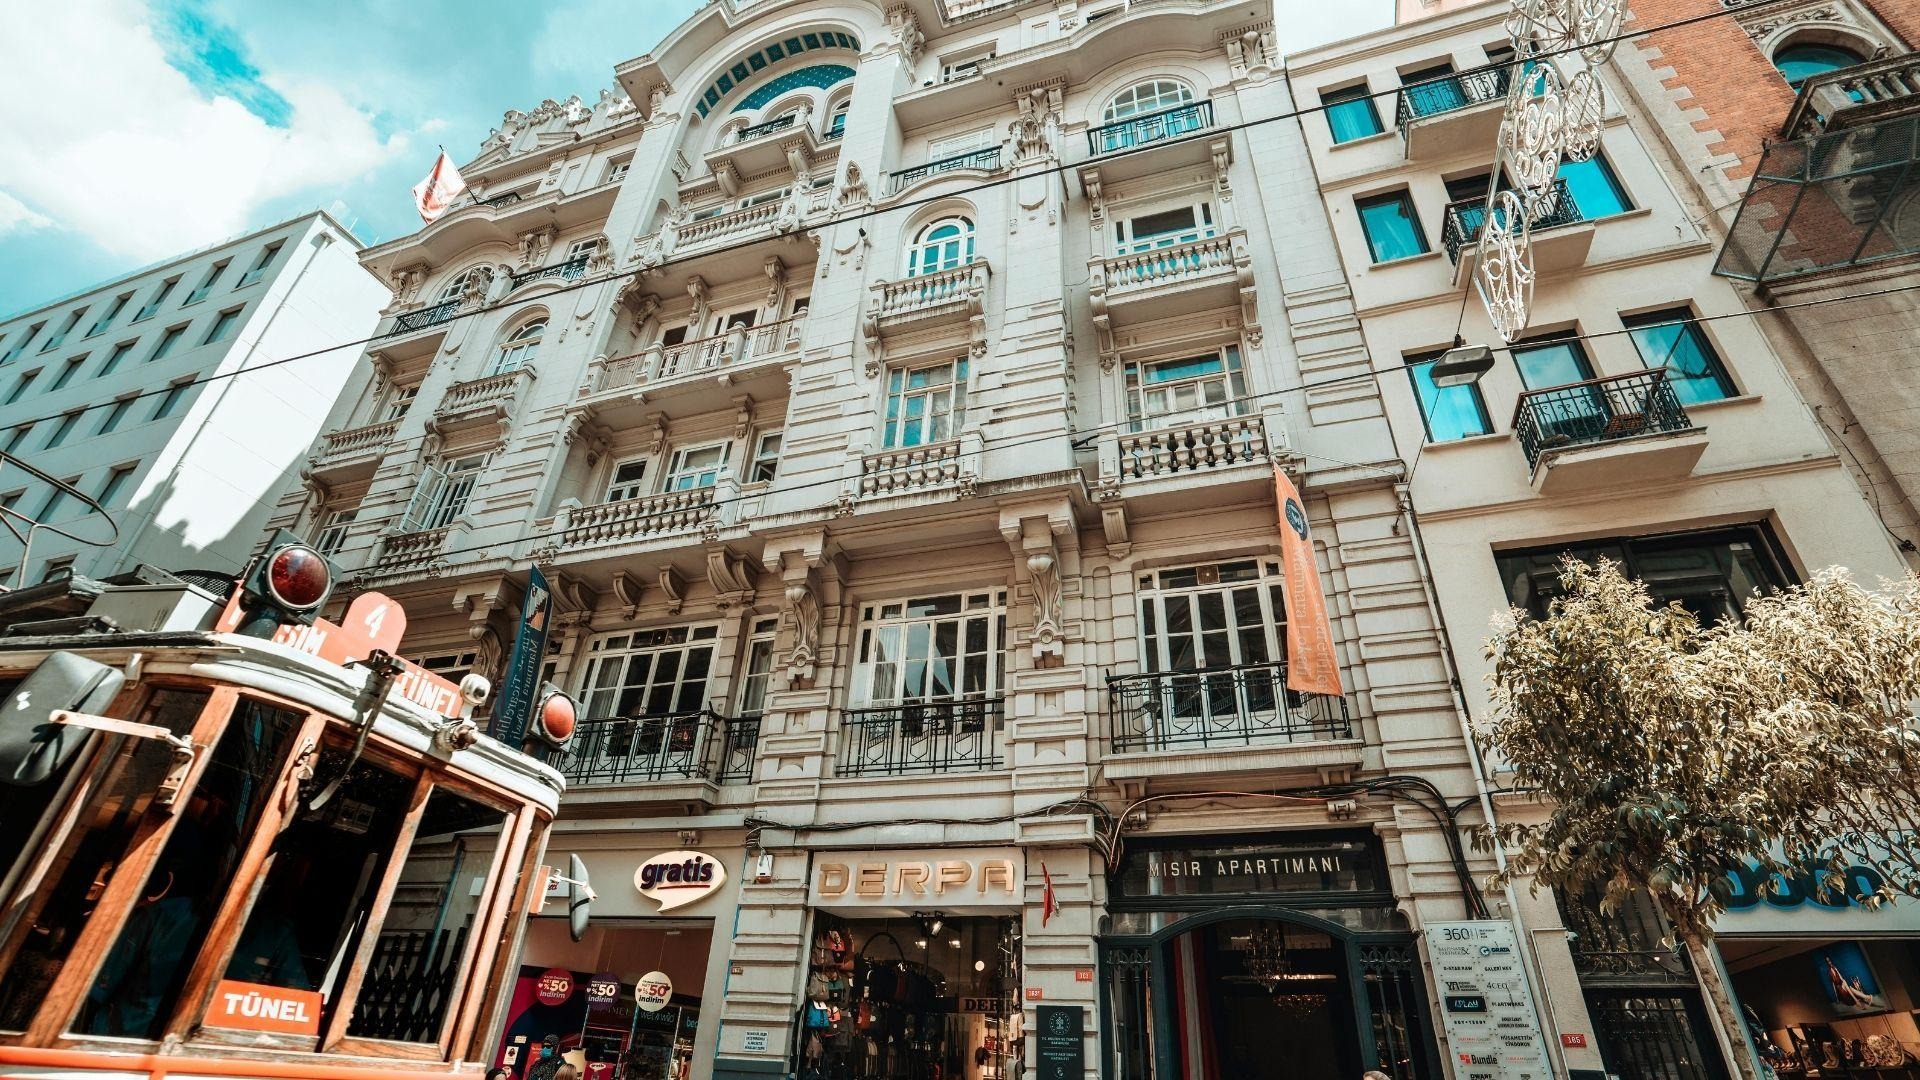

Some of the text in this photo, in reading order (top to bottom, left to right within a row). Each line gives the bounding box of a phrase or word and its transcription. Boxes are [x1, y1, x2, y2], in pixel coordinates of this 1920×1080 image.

[364, 603, 388, 638] 4
[640, 856, 713, 889] gratis
[1149, 857, 1341, 877] MISIR APARTIMANI
[818, 860, 1015, 896] DERPA
[1443, 928, 1470, 940] 360
[540, 990, 566, 999] indirim
[588, 995, 613, 1003] indirim
[639, 995, 664, 1004] indirim
[224, 991, 310, 1023] TÜNEL
[1471, 1054, 1498, 1065] Bundle
